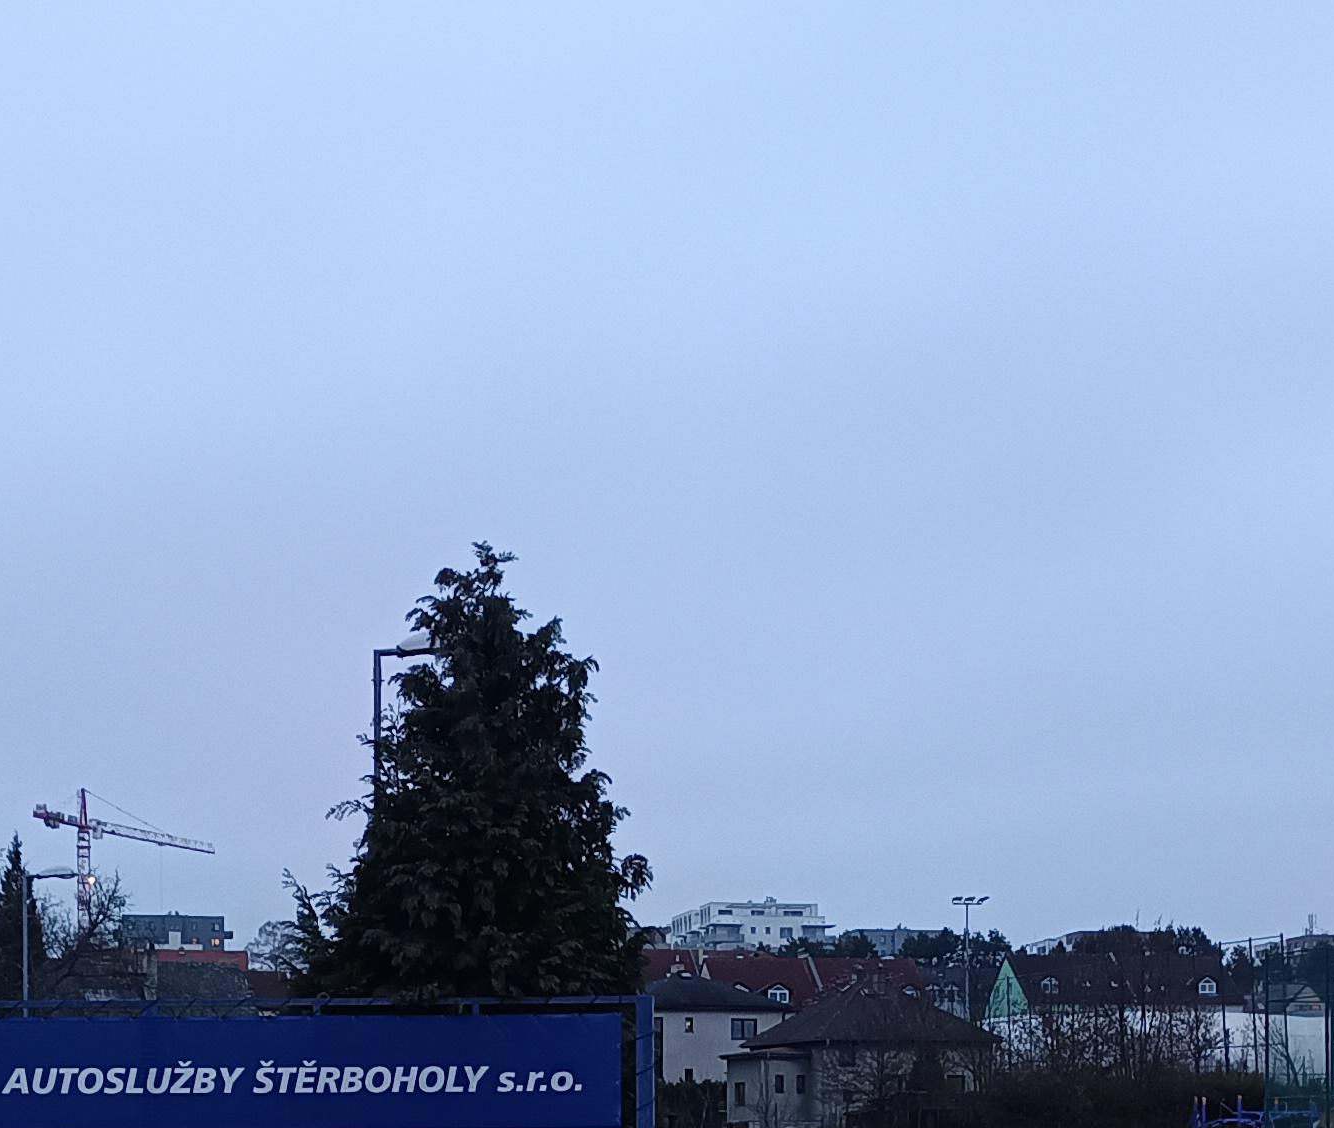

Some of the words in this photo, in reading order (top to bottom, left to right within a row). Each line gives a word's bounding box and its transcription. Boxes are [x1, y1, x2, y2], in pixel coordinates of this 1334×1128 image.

[1, 1061, 244, 1095] AUTOSLUŽBY
[252, 1059, 490, 1094] ŠTĚRBOHOLY
[497, 1070, 583, 1093] s.r.o.
